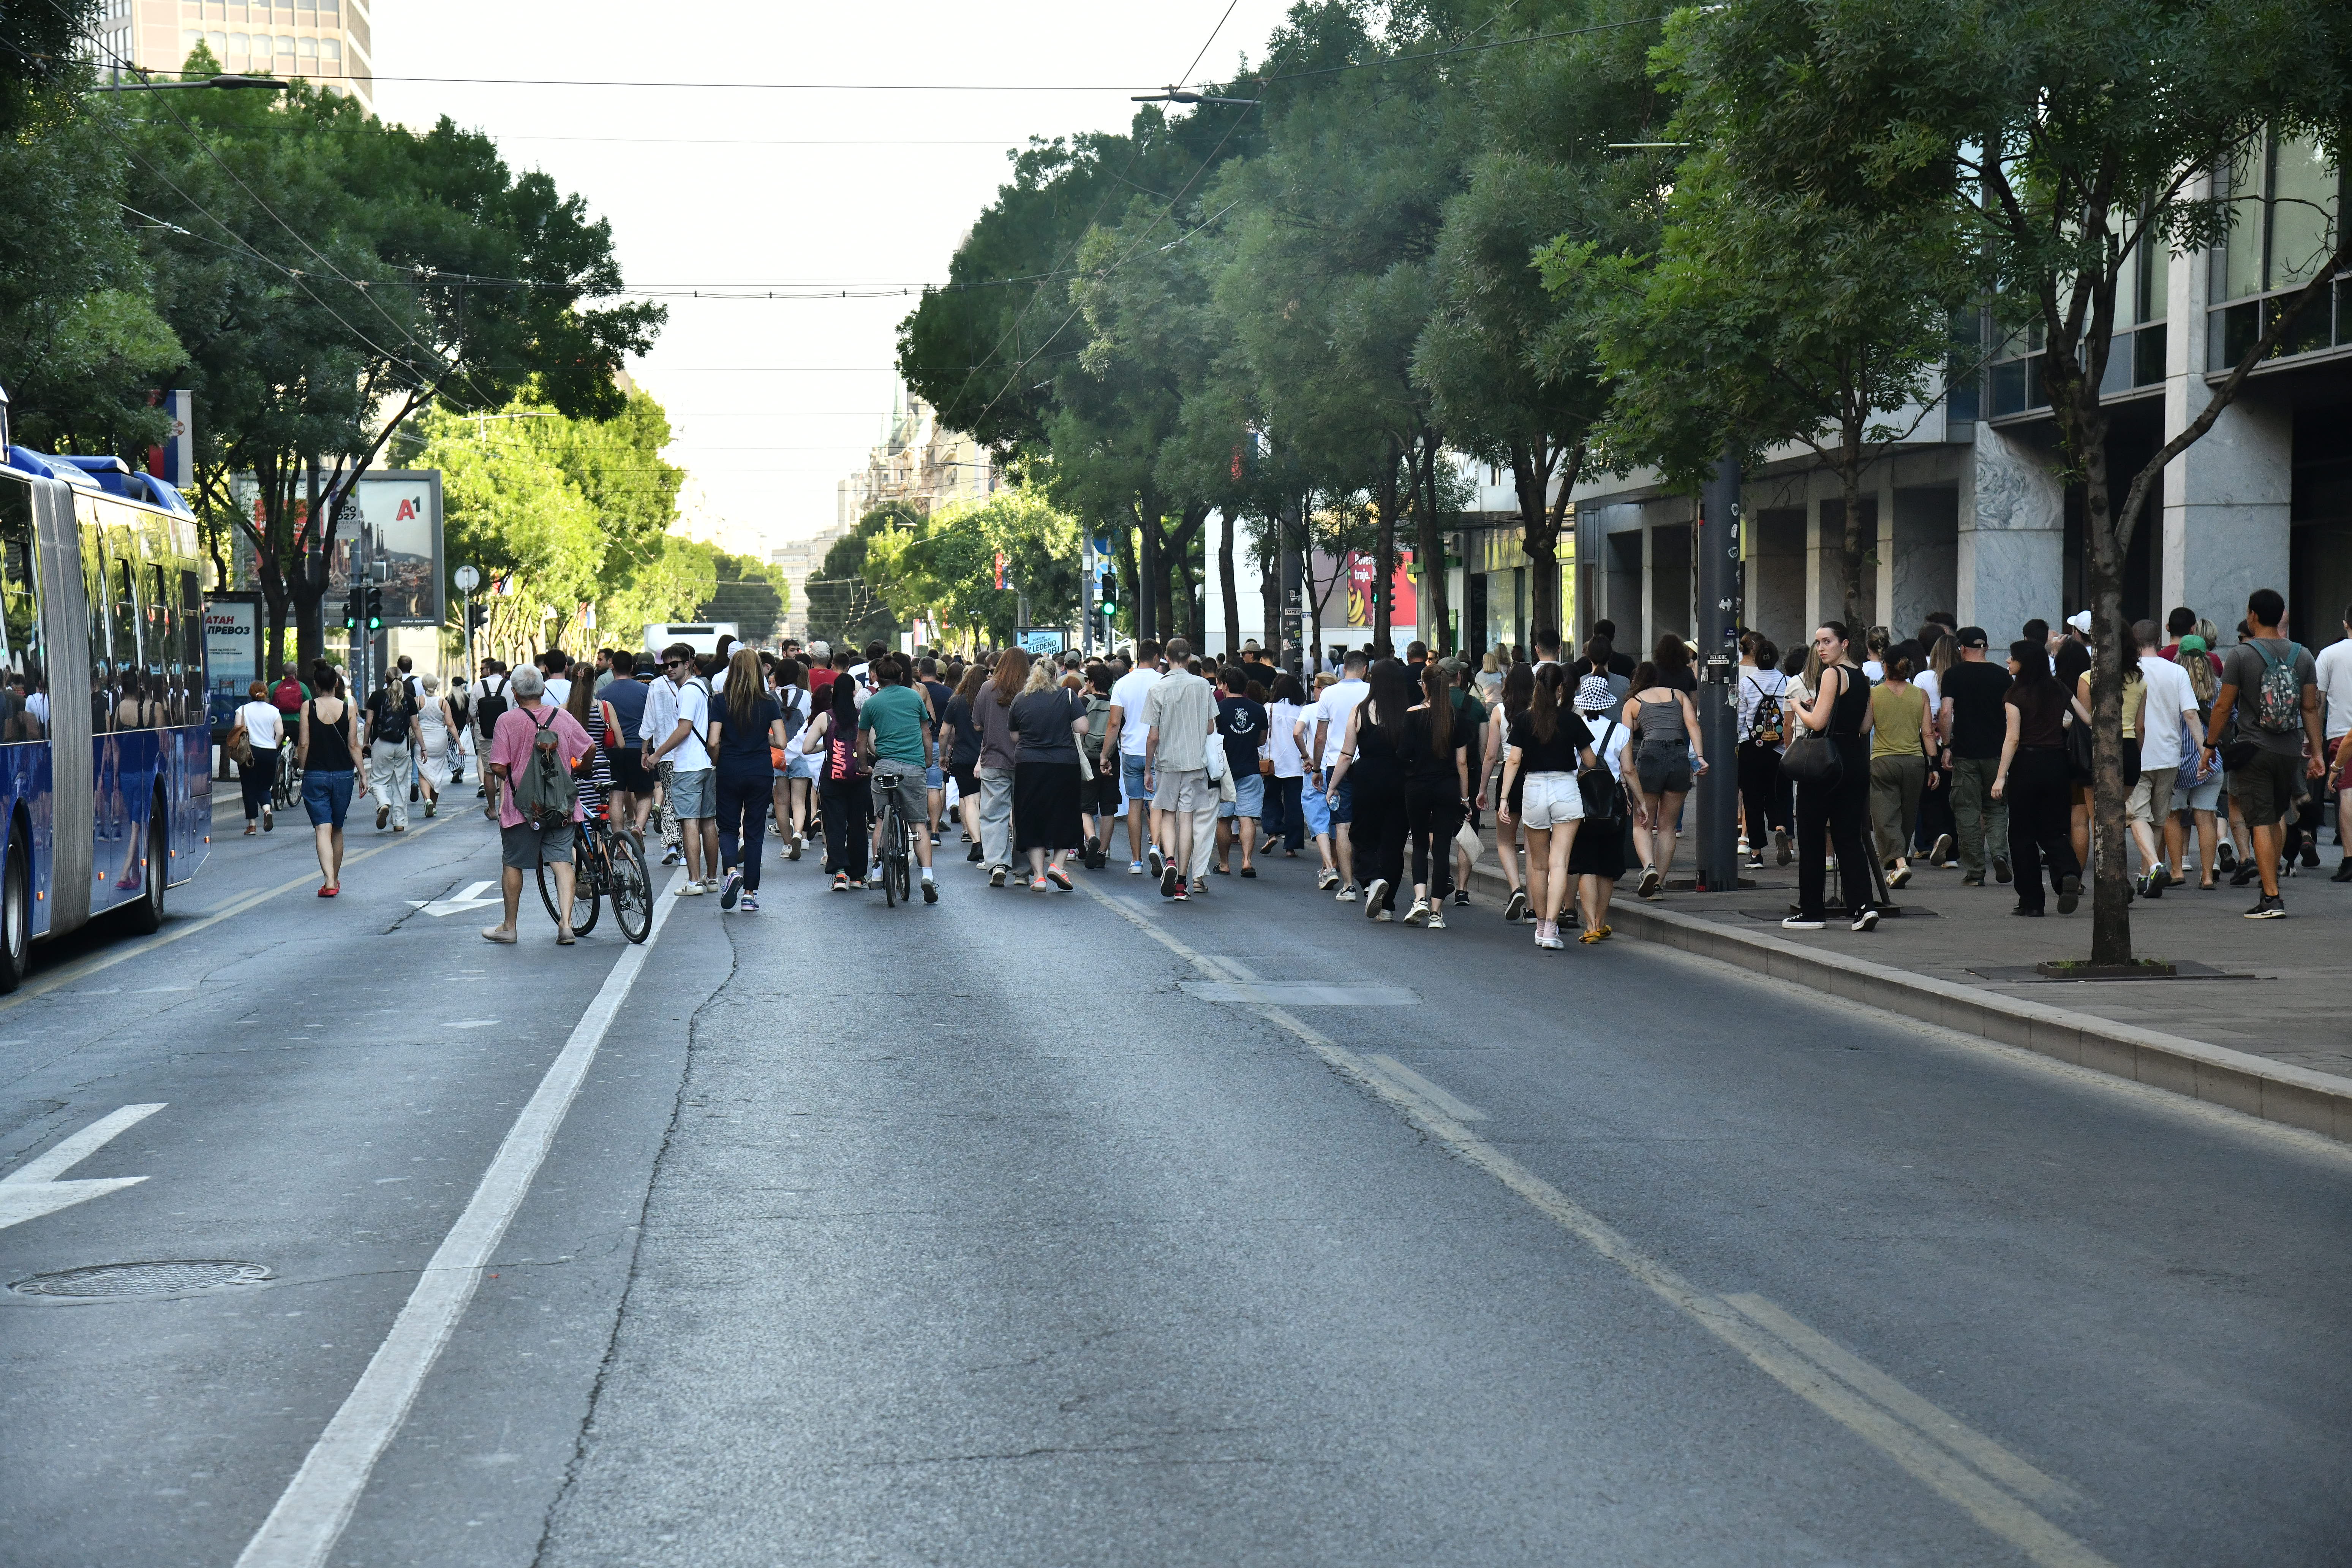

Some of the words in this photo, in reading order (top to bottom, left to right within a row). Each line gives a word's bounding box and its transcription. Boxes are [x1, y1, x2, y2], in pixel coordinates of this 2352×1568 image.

[396, 496, 420, 521] A1
[1355, 554, 1373, 565] Pover
[1355, 568, 1370, 582] traje.
[206, 615, 234, 624] АТАН
[207, 626, 250, 635] ПРЕВОЗ
[1033, 640, 1056, 652] LEDENO
[1242, 722, 1255, 734] STUDENTE
[831, 738, 847, 779] PUMA
